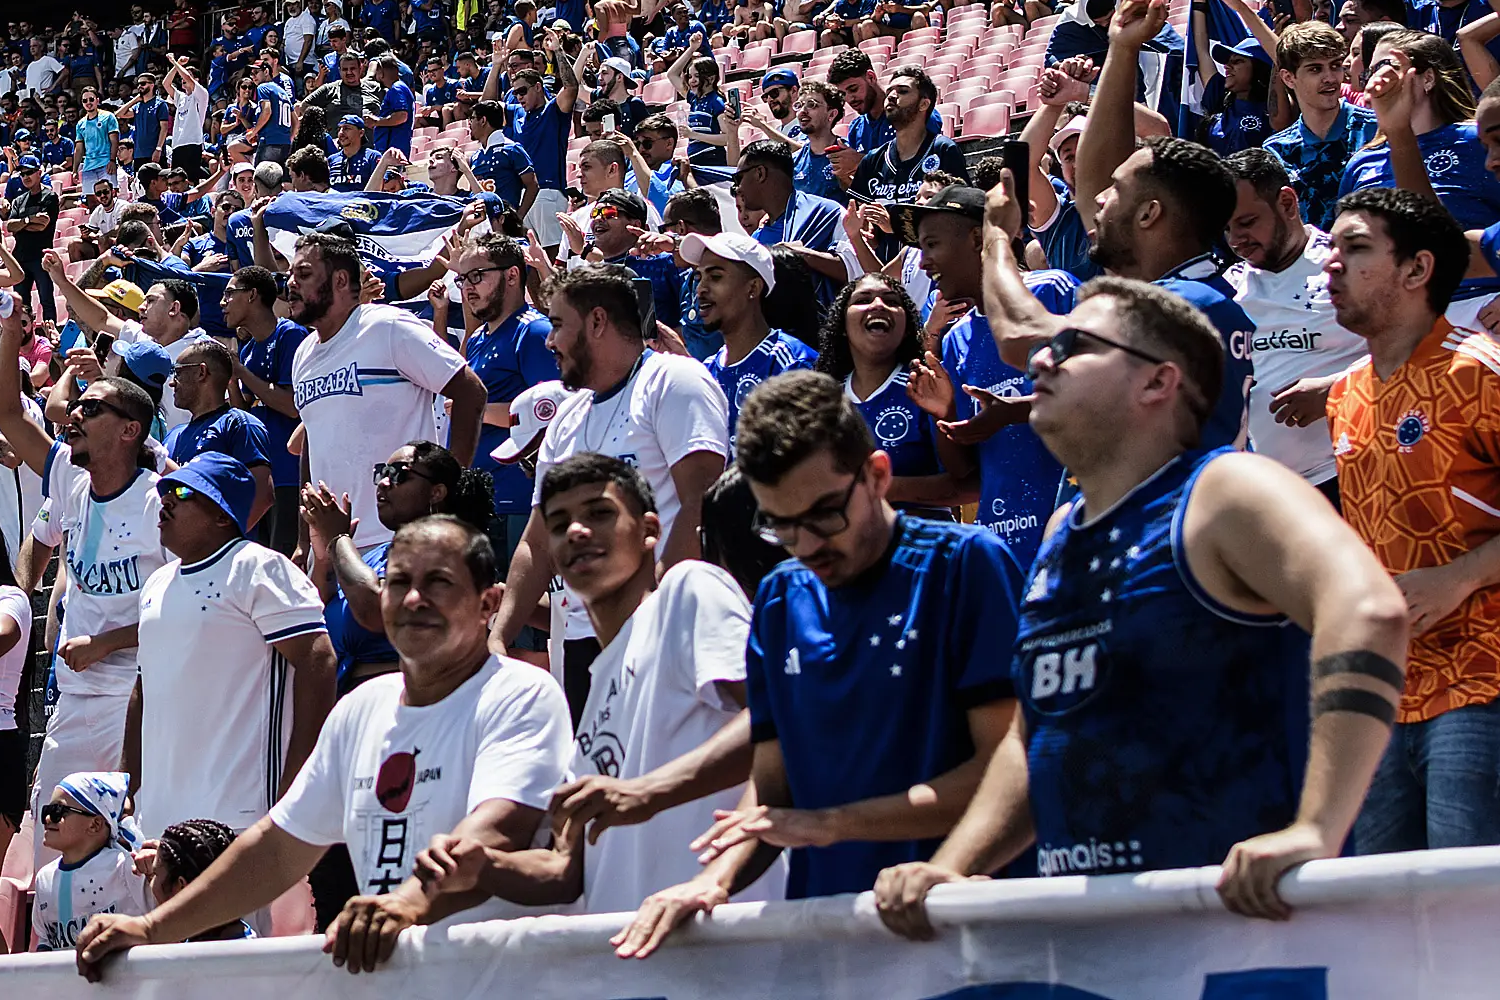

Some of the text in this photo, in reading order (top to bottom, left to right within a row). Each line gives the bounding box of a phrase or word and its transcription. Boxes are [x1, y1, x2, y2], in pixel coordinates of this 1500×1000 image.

[277, 100, 292, 128] 10
[1250, 327, 1322, 352] etfair
[296, 361, 363, 411] BERABA
[975, 514, 1037, 538] ampion
[67, 554, 141, 595] ACATU
[1031, 643, 1098, 700] BH
[416, 766, 443, 785] JAPAN
